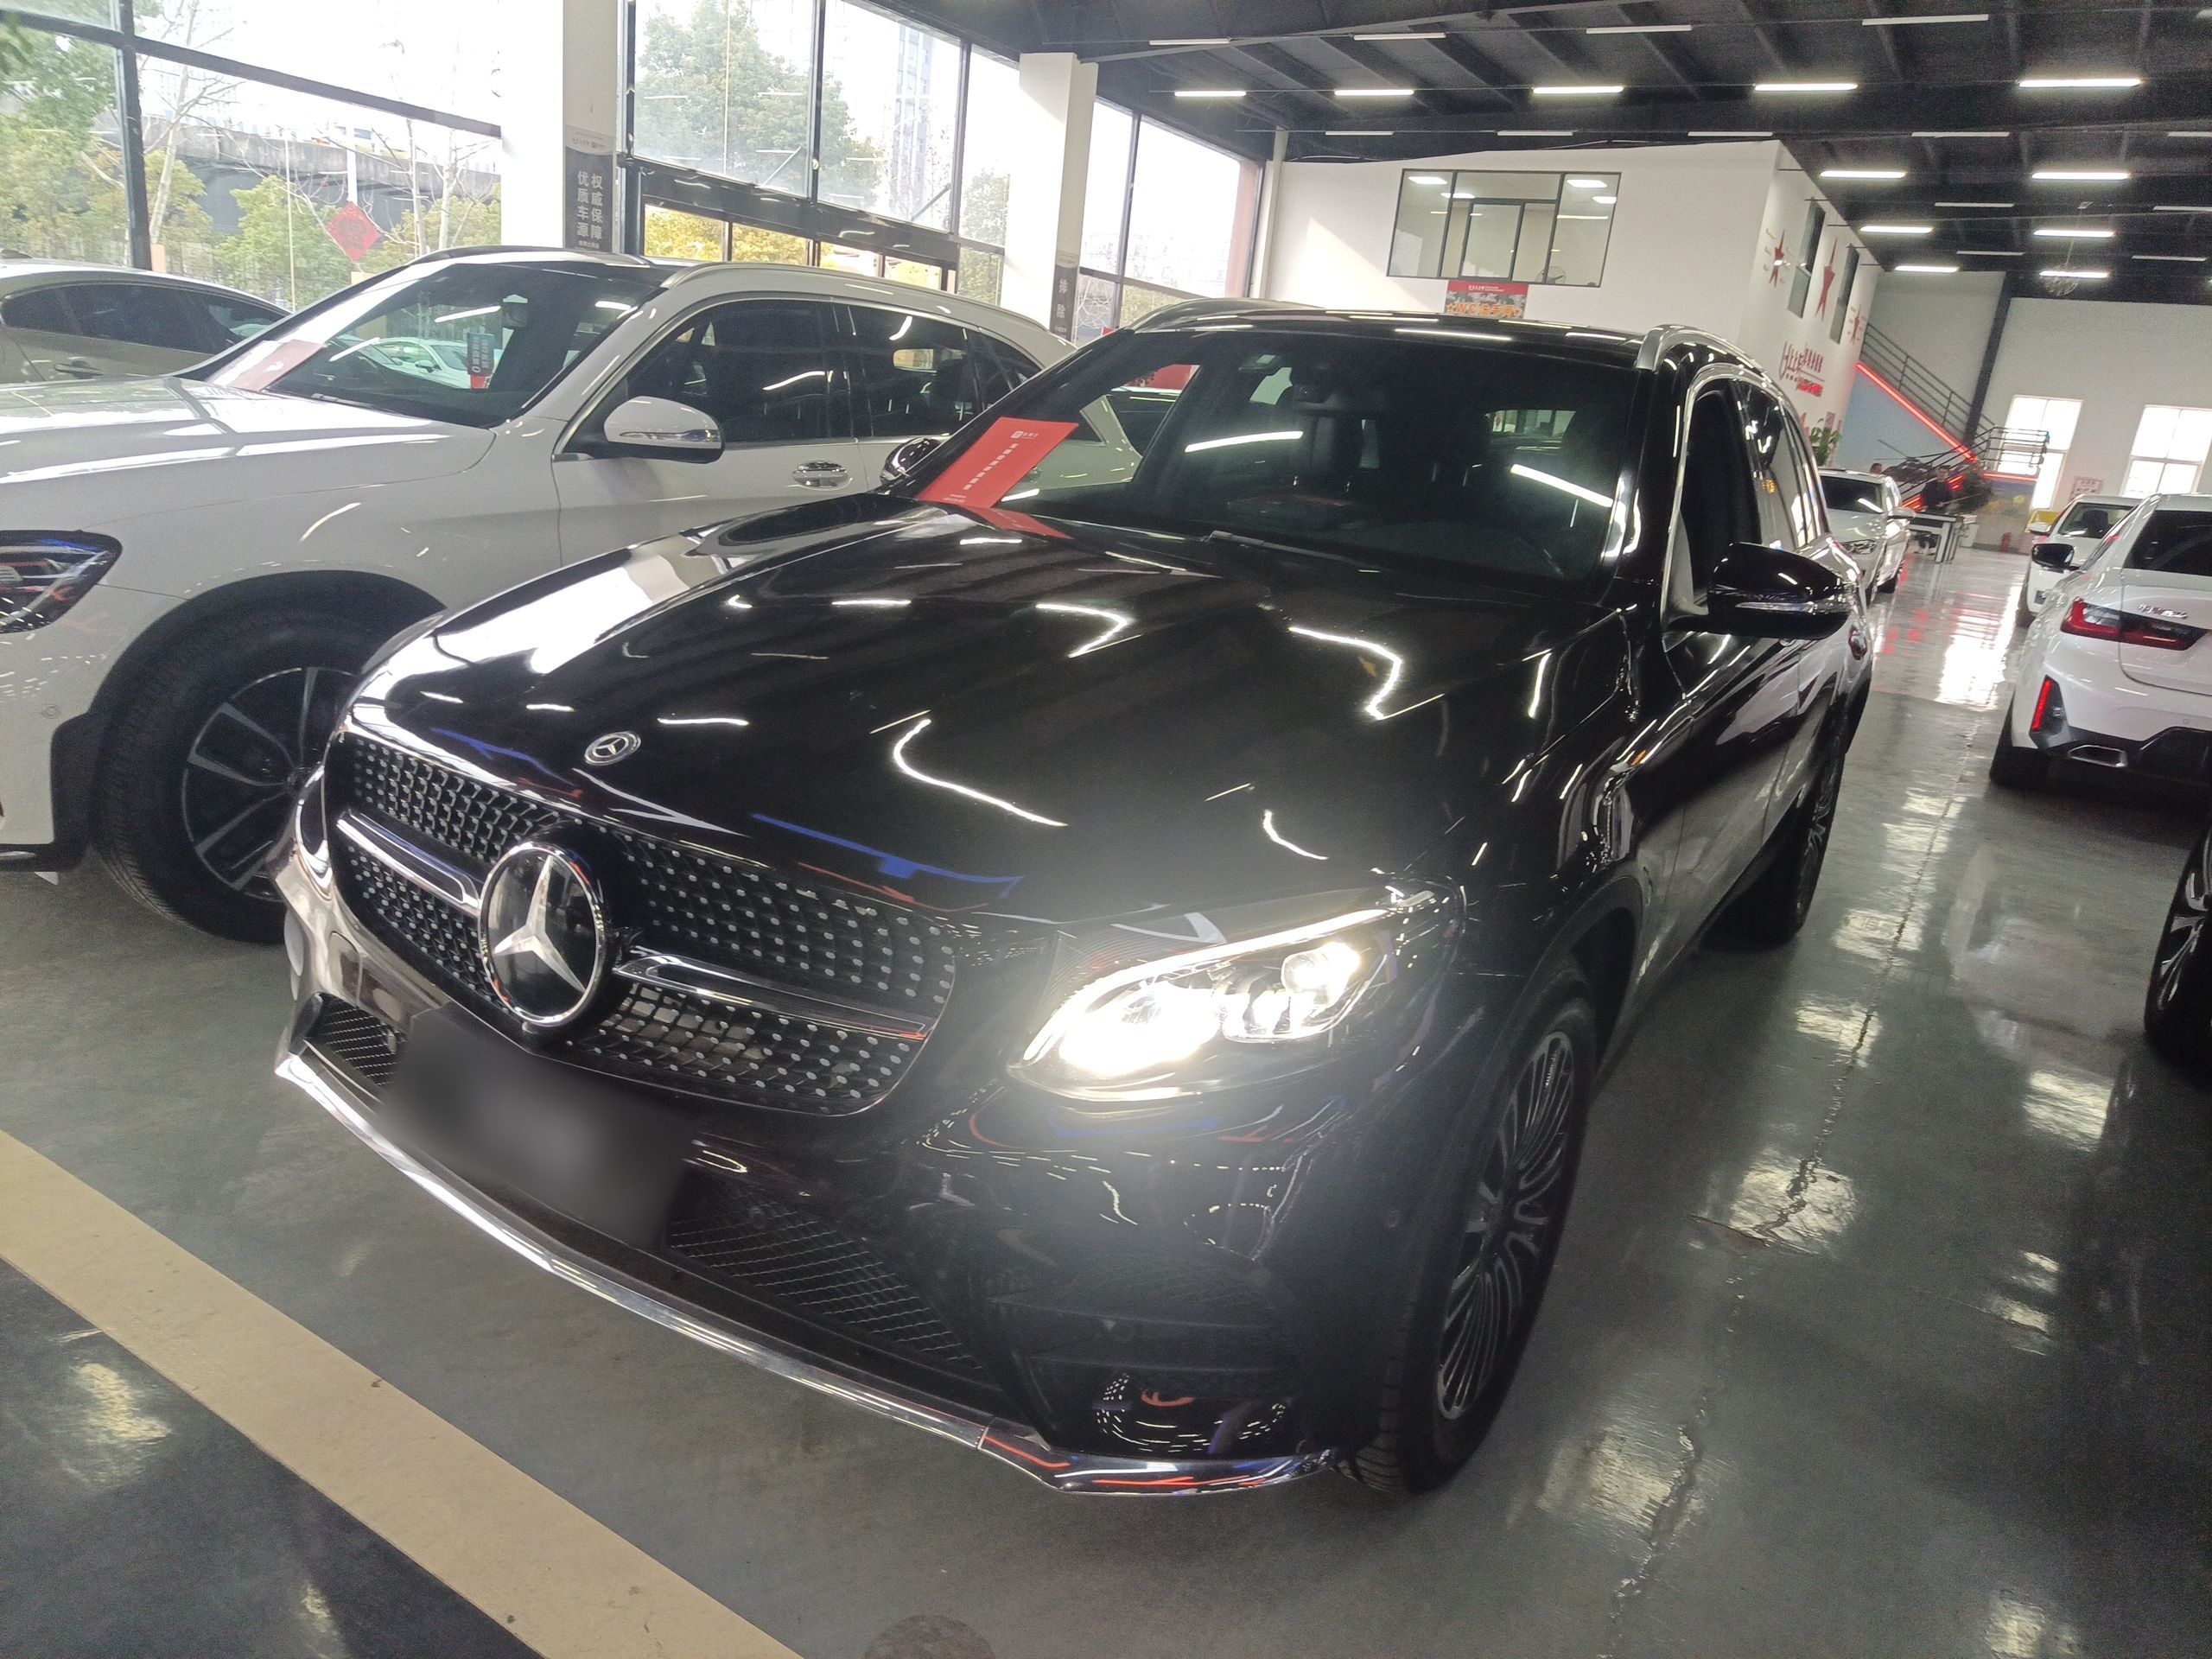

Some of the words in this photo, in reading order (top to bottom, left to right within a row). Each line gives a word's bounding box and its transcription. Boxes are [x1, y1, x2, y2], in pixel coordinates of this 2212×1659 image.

[576, 171, 589, 237] 优质车源
[591, 174, 603, 240] 权威保障
